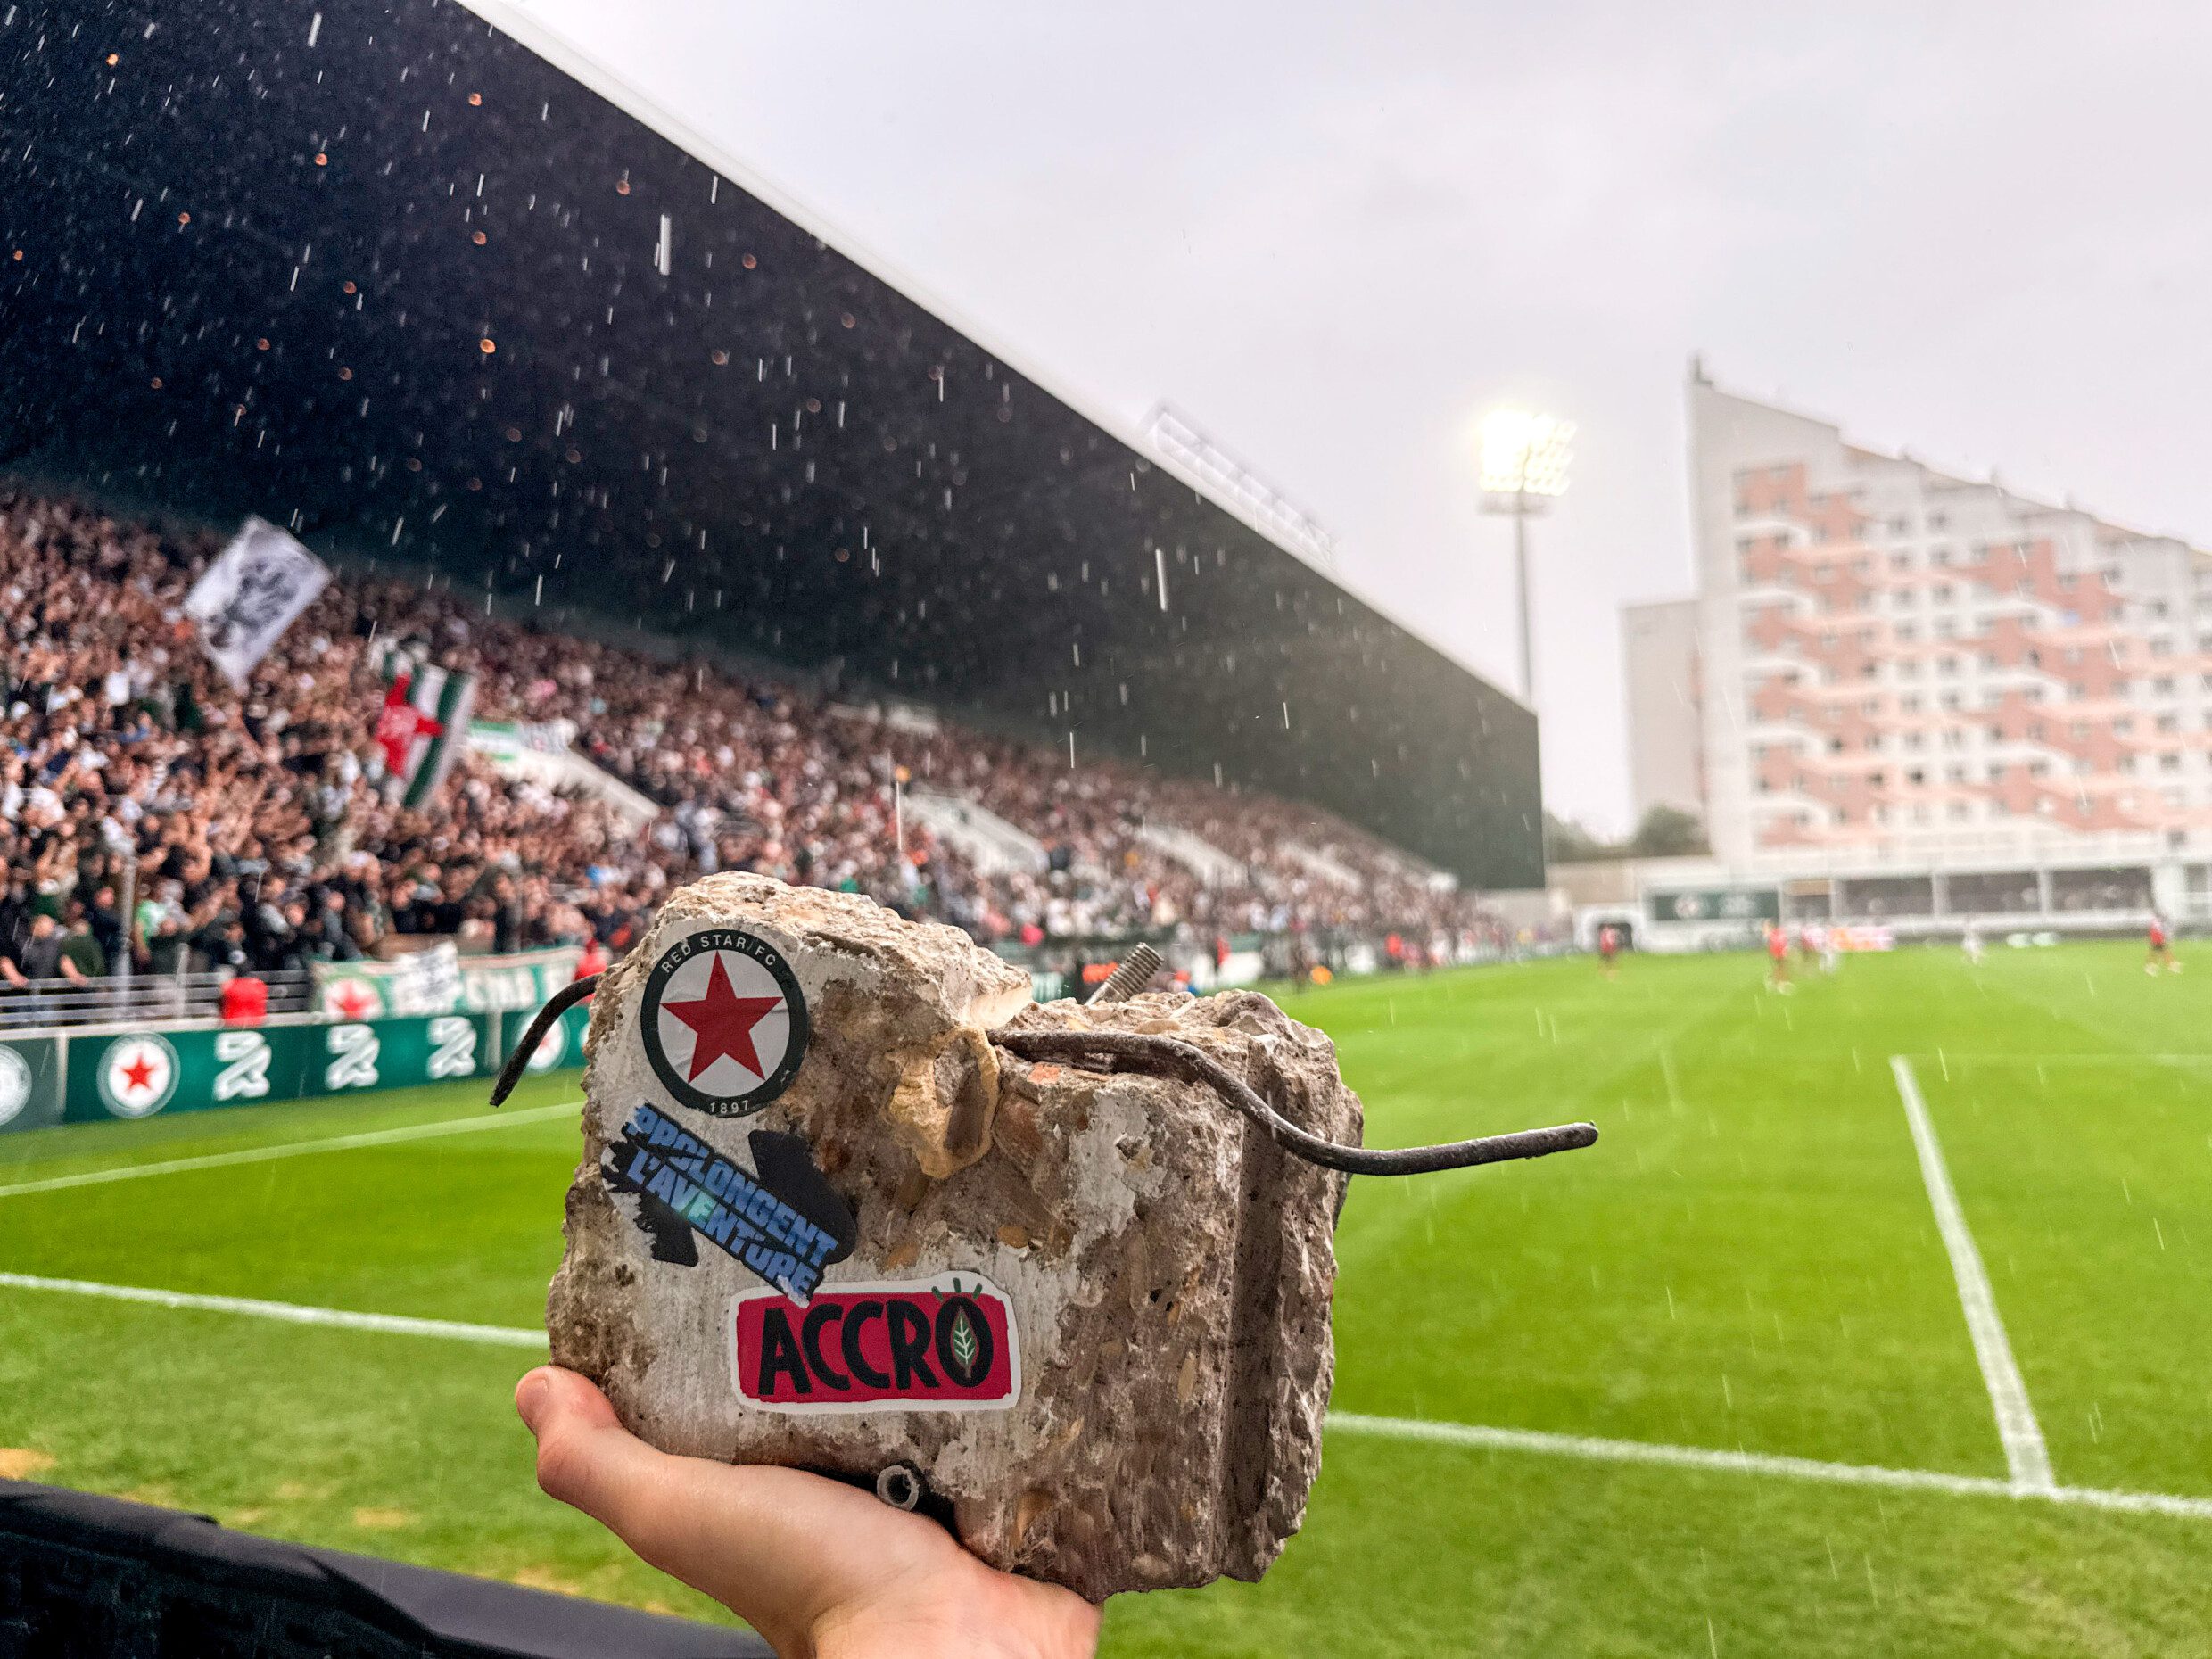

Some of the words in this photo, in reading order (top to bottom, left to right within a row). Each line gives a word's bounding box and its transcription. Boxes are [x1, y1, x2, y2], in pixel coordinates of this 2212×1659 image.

[661, 942, 692, 974] RED
[755, 945, 777, 966] FC
[710, 1100, 749, 1113] 1897
[625, 1103, 838, 1267] PROLONGENT
[627, 1146, 819, 1294] L'AVENTURE
[758, 1296, 995, 1396] ACCRO
